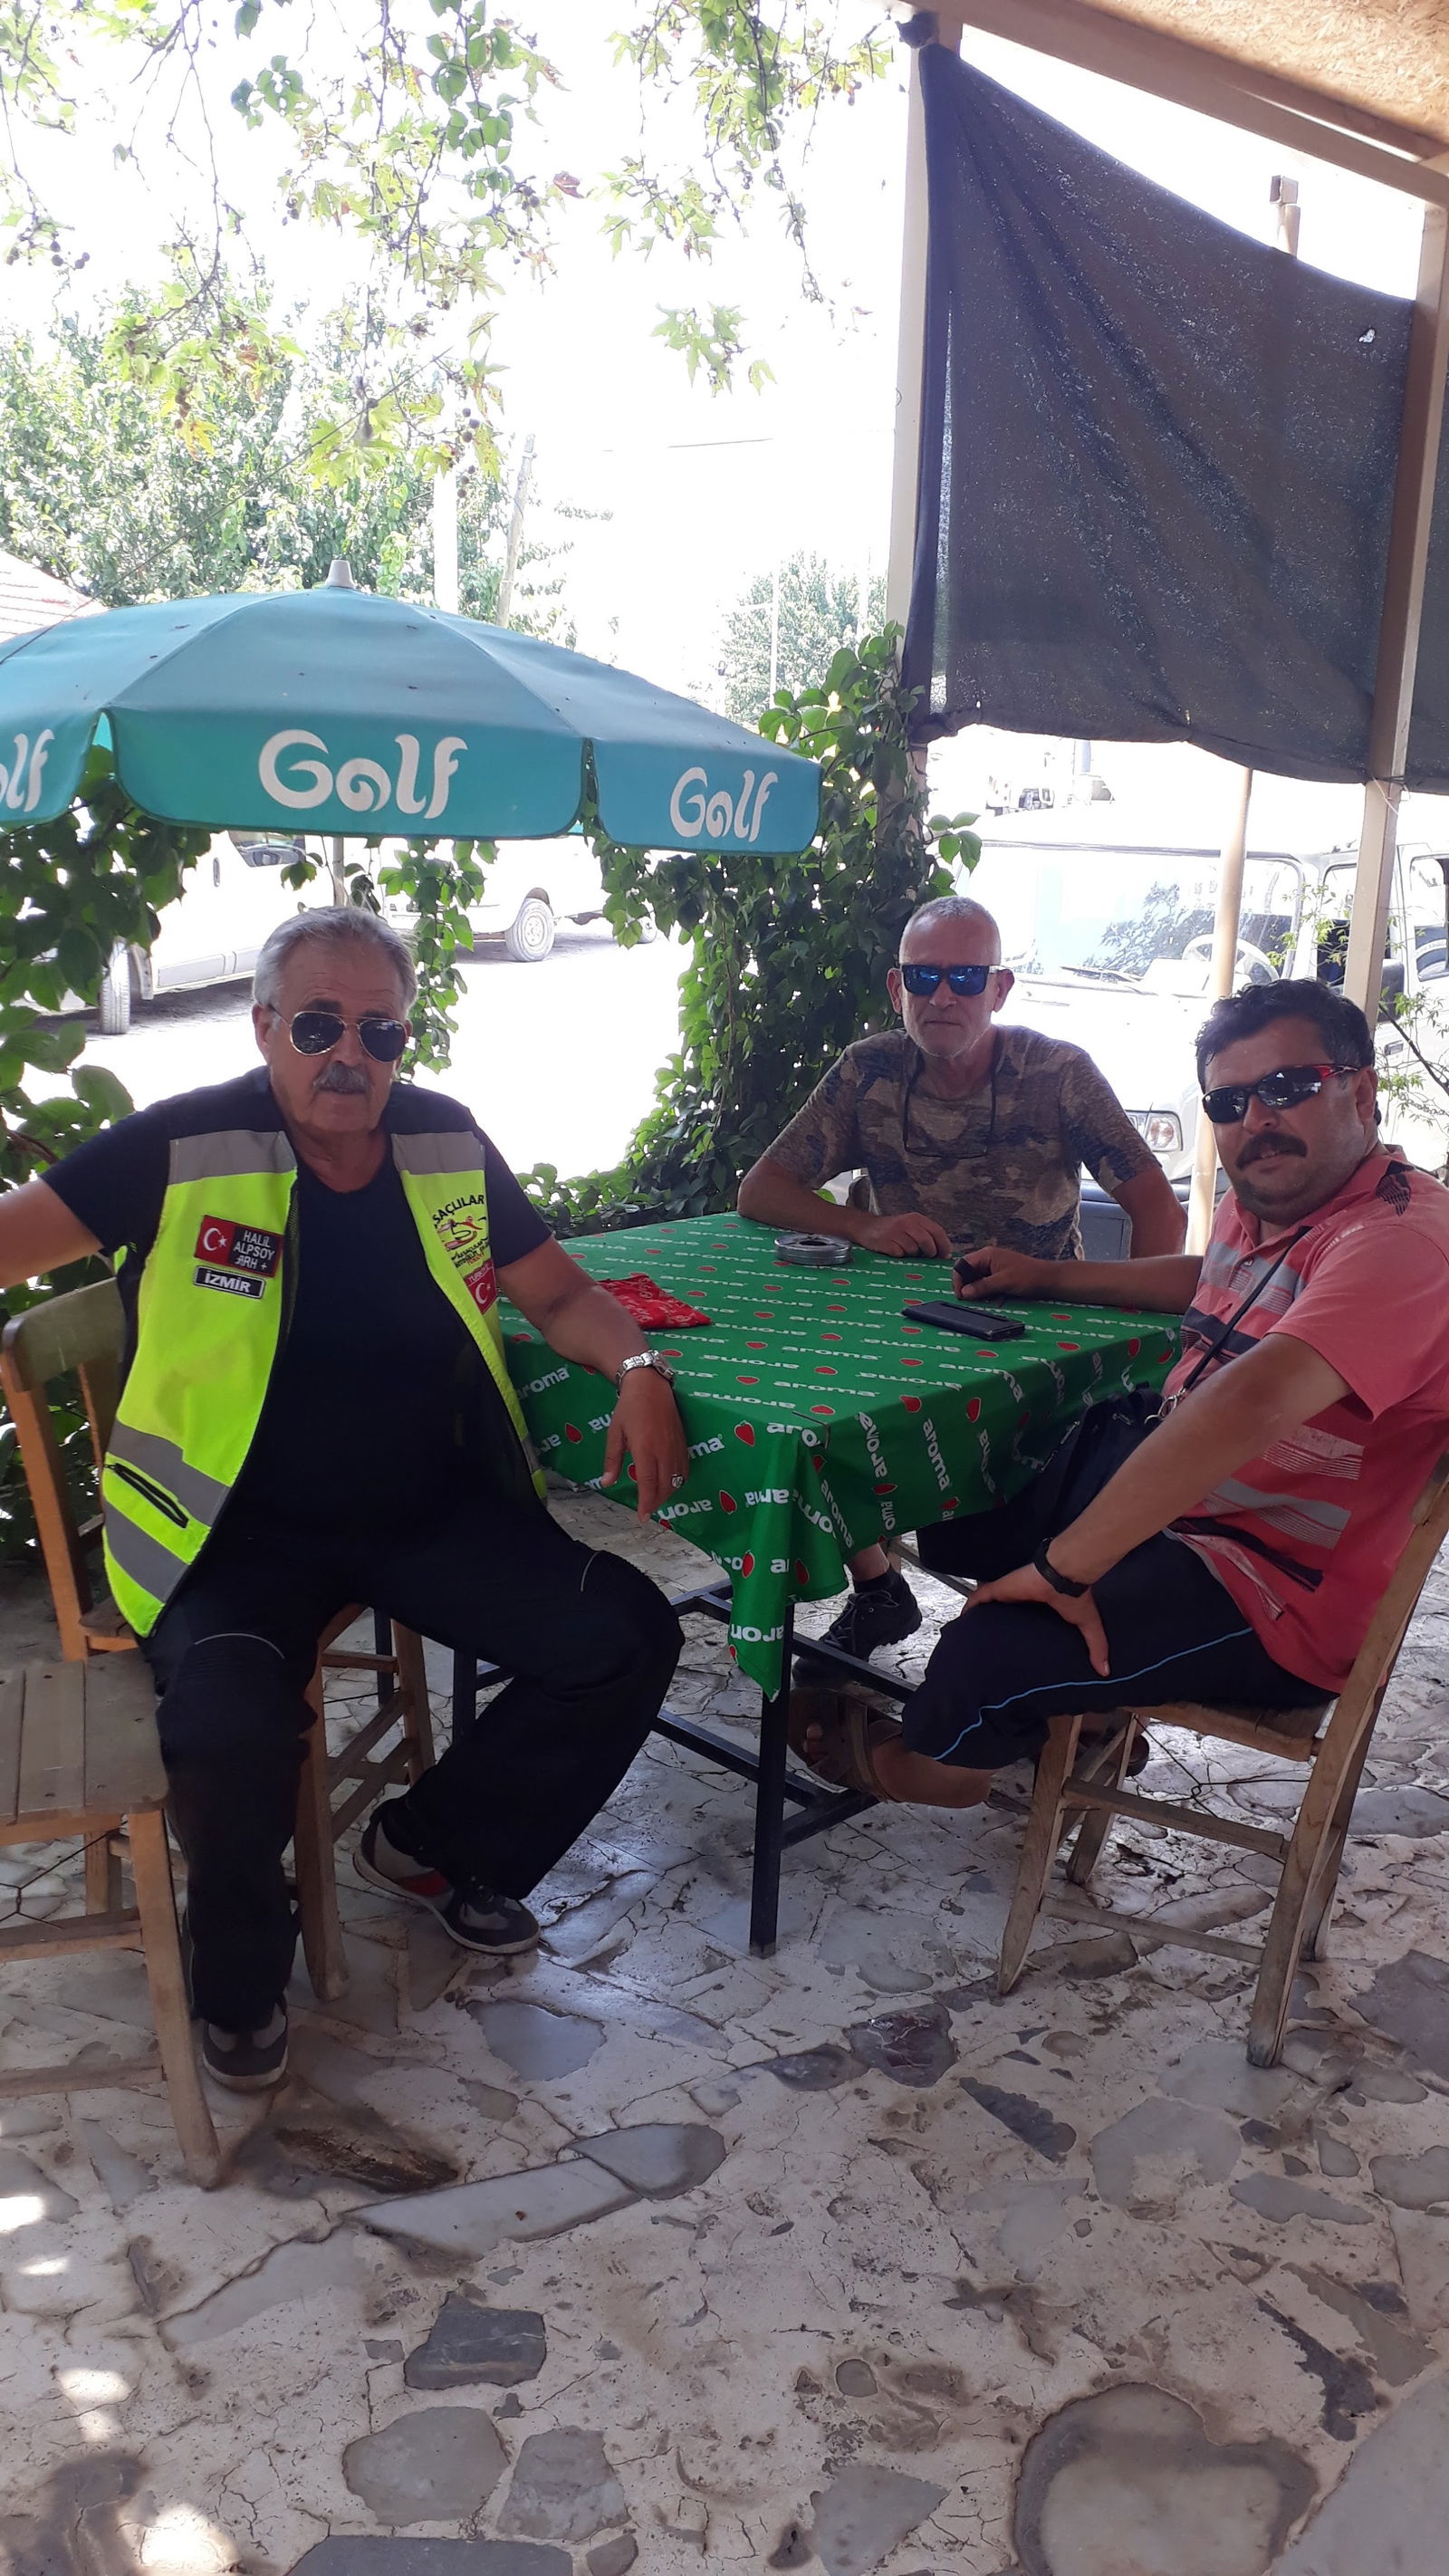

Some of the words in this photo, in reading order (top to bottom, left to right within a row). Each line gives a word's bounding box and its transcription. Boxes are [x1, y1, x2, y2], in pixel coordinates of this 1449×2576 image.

[258, 728, 468, 819] Golf
[670, 766, 779, 842] Golf
[233, 1241, 275, 1261] ALPSOY
[675, 1252, 754, 1263] aroma
[204, 1270, 252, 1293] İZMİR
[660, 1274, 744, 1287] aroma
[734, 1269, 818, 1281] aroma
[725, 1294, 813, 1307] aroma
[795, 1288, 883, 1301] aroma
[713, 1322, 808, 1336] aroma
[790, 1316, 882, 1329] aroma
[782, 1346, 879, 1360] aroma
[861, 1337, 961, 1353] aroma
[701, 1354, 801, 1370] aroma
[772, 1381, 877, 1398] aroma
[856, 1371, 962, 1392] aroma
[689, 1390, 797, 1409] aroma
[922, 1418, 952, 1492] aroma
